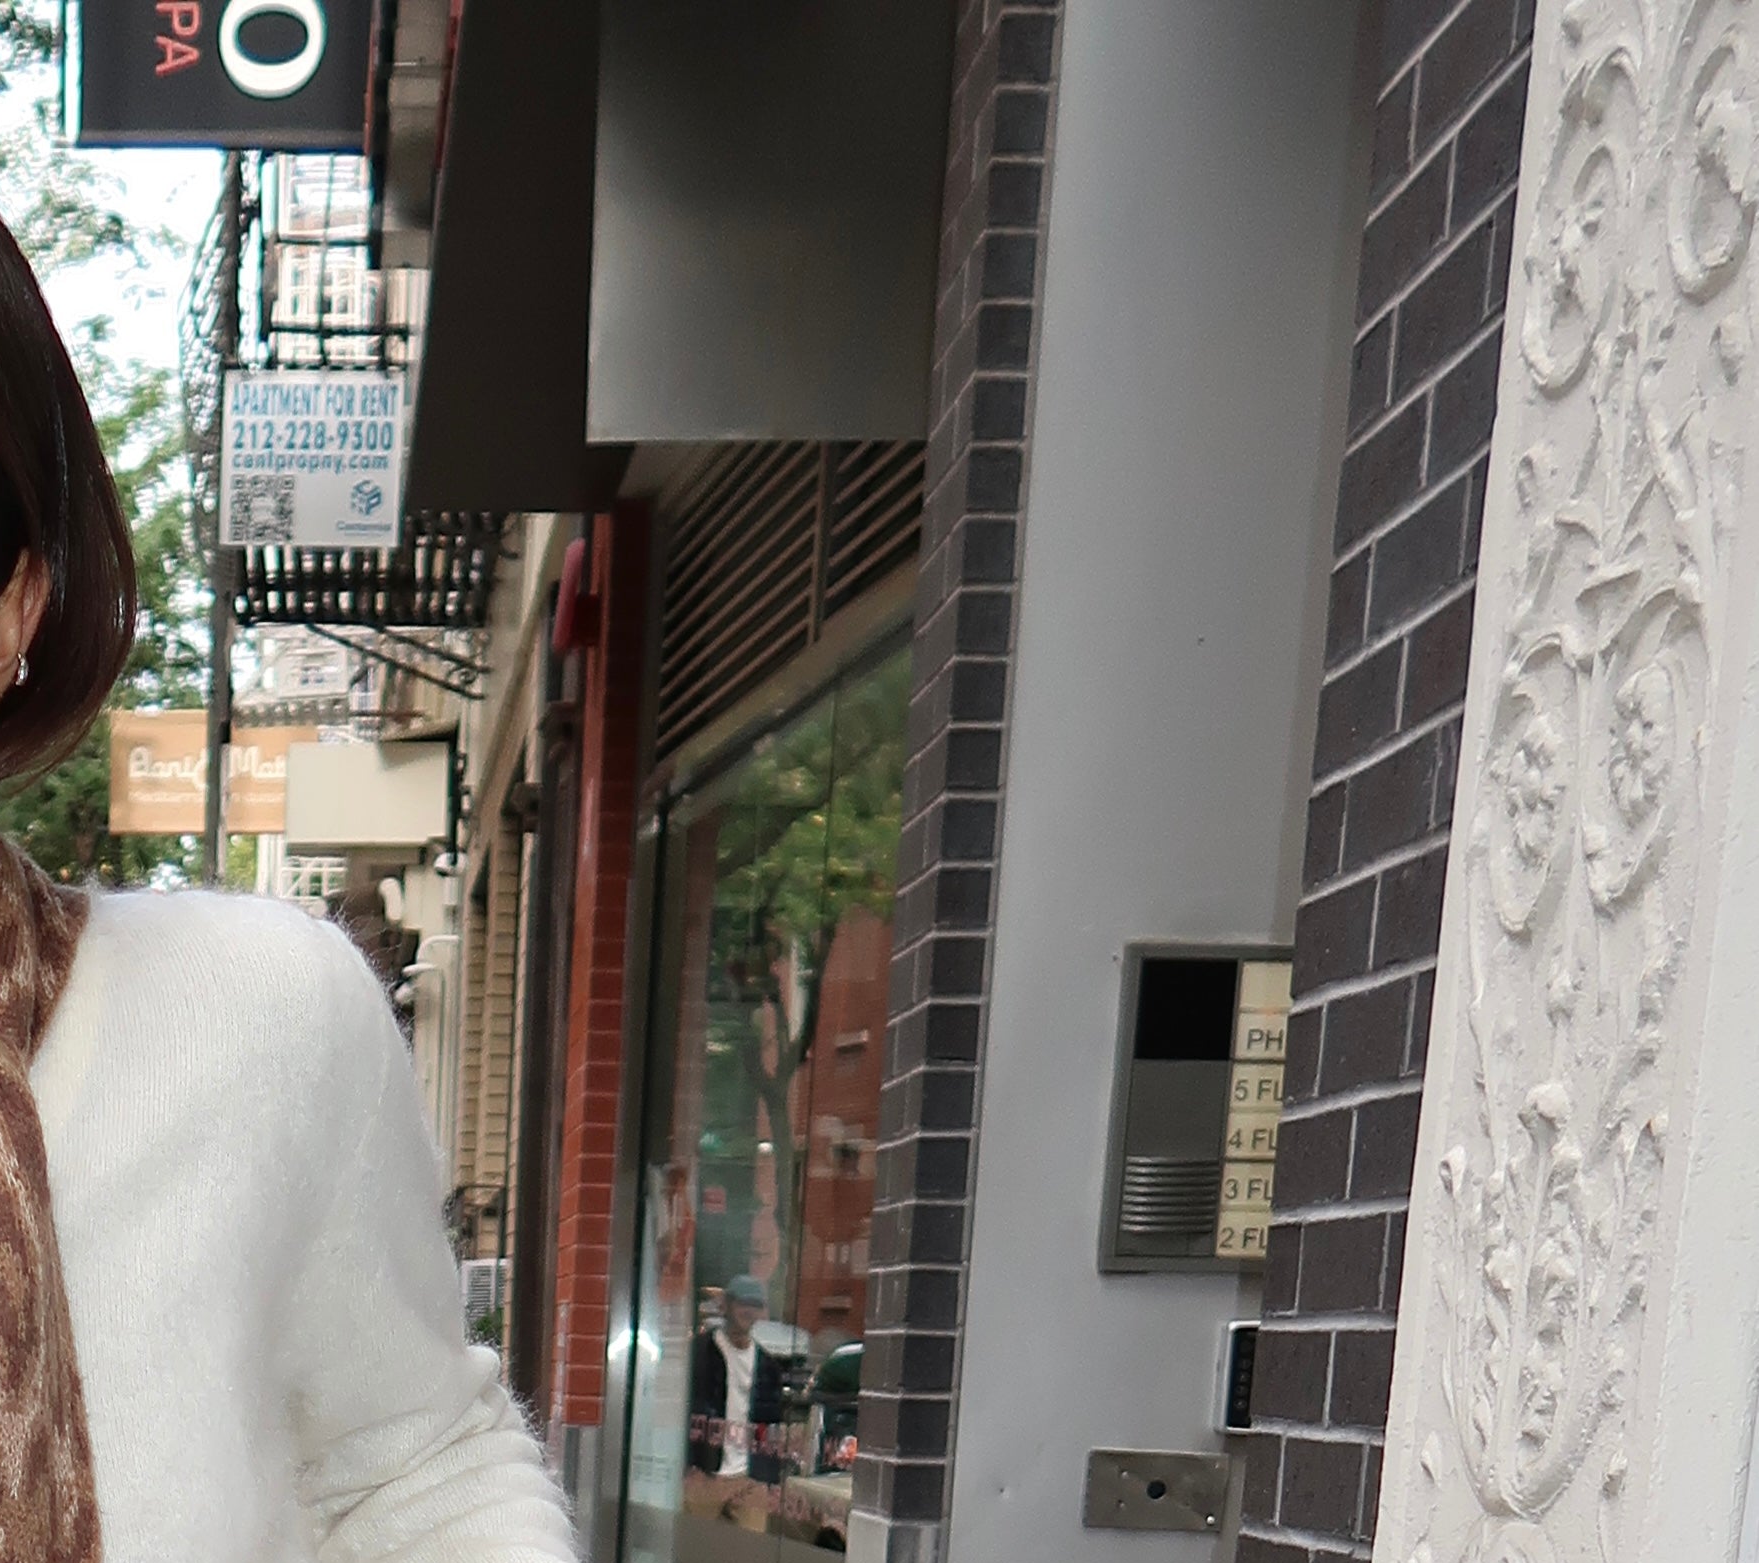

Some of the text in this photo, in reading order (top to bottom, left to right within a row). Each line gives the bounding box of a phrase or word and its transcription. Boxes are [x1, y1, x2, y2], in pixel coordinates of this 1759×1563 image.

[231, 384, 399, 417] APARTMENT FOR RENT
[1246, 1029, 1284, 1051] PH
[1234, 1079, 1248, 1101] 5
[1228, 1128, 1242, 1149] 4
[1225, 1178, 1239, 1199] 3
[1218, 1227, 1235, 1248] 2
